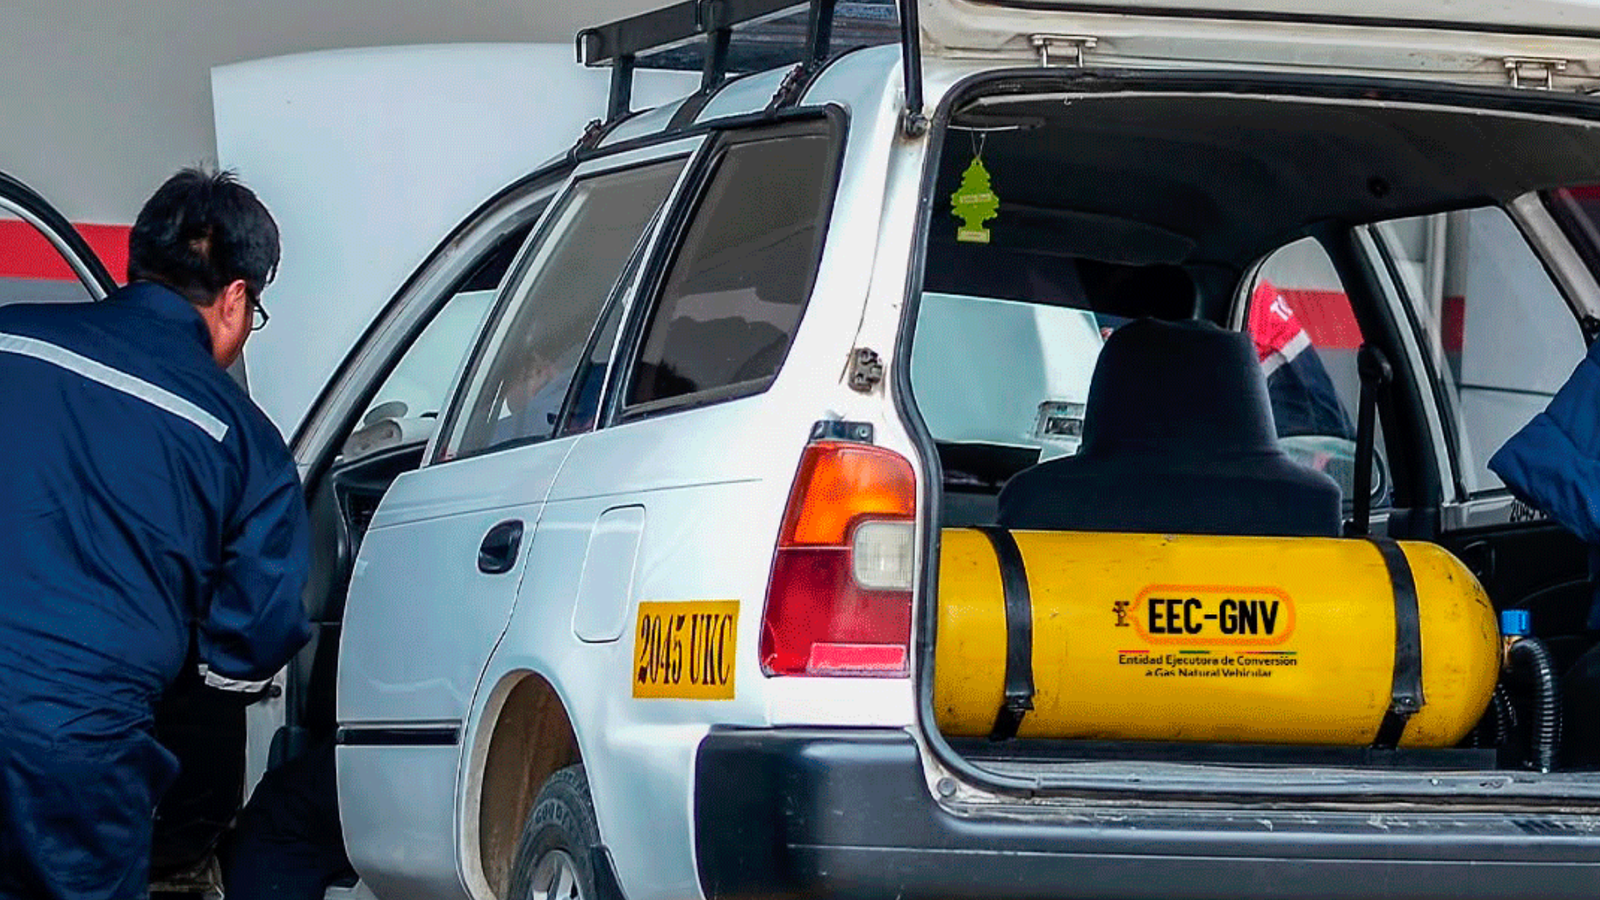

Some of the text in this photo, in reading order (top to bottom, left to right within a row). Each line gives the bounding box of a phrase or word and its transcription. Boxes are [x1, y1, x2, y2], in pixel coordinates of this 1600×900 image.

[1148, 598, 1279, 635] EEC-GNV
[638, 613, 733, 686] 2045 UKC
[1118, 654, 1297, 668] Entidad Ejecutora de Conversión
[1154, 668, 1176, 677] Gas
[1178, 668, 1220, 677] Natural
